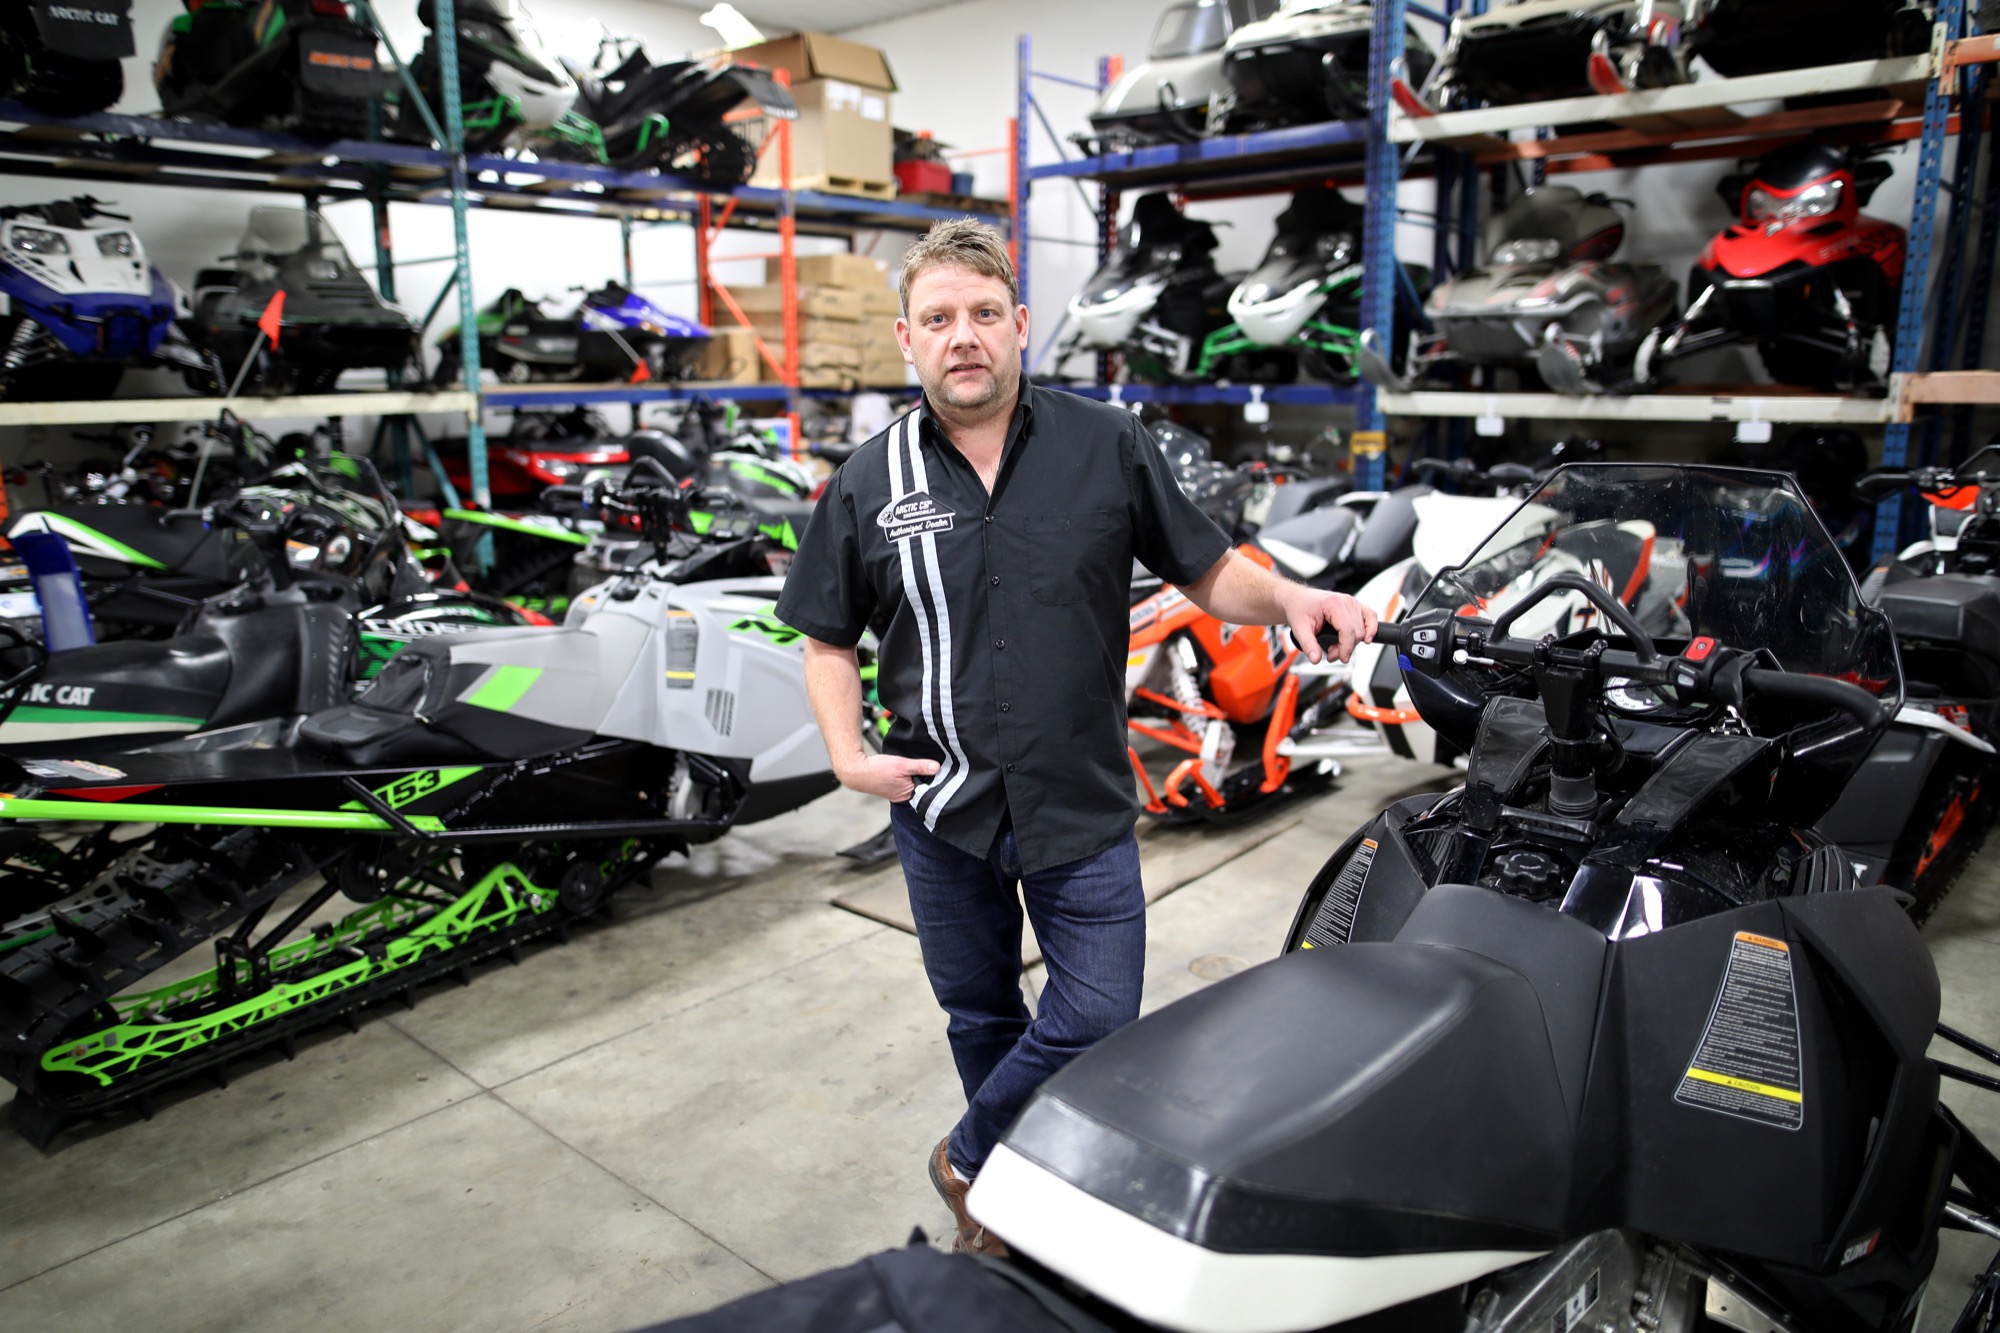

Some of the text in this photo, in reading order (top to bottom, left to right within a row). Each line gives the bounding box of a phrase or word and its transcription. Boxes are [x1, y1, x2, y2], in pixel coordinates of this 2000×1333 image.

[95, 11, 119, 26] CAT
[895, 502, 918, 516] ARCTIC
[903, 508, 936, 519] SNOWMOBILES
[890, 519, 949, 538] Authorized Dealer
[55, 685, 95, 706] CAT
[377, 769, 441, 804] 153
[1734, 1080, 1761, 1091] CAUTION
